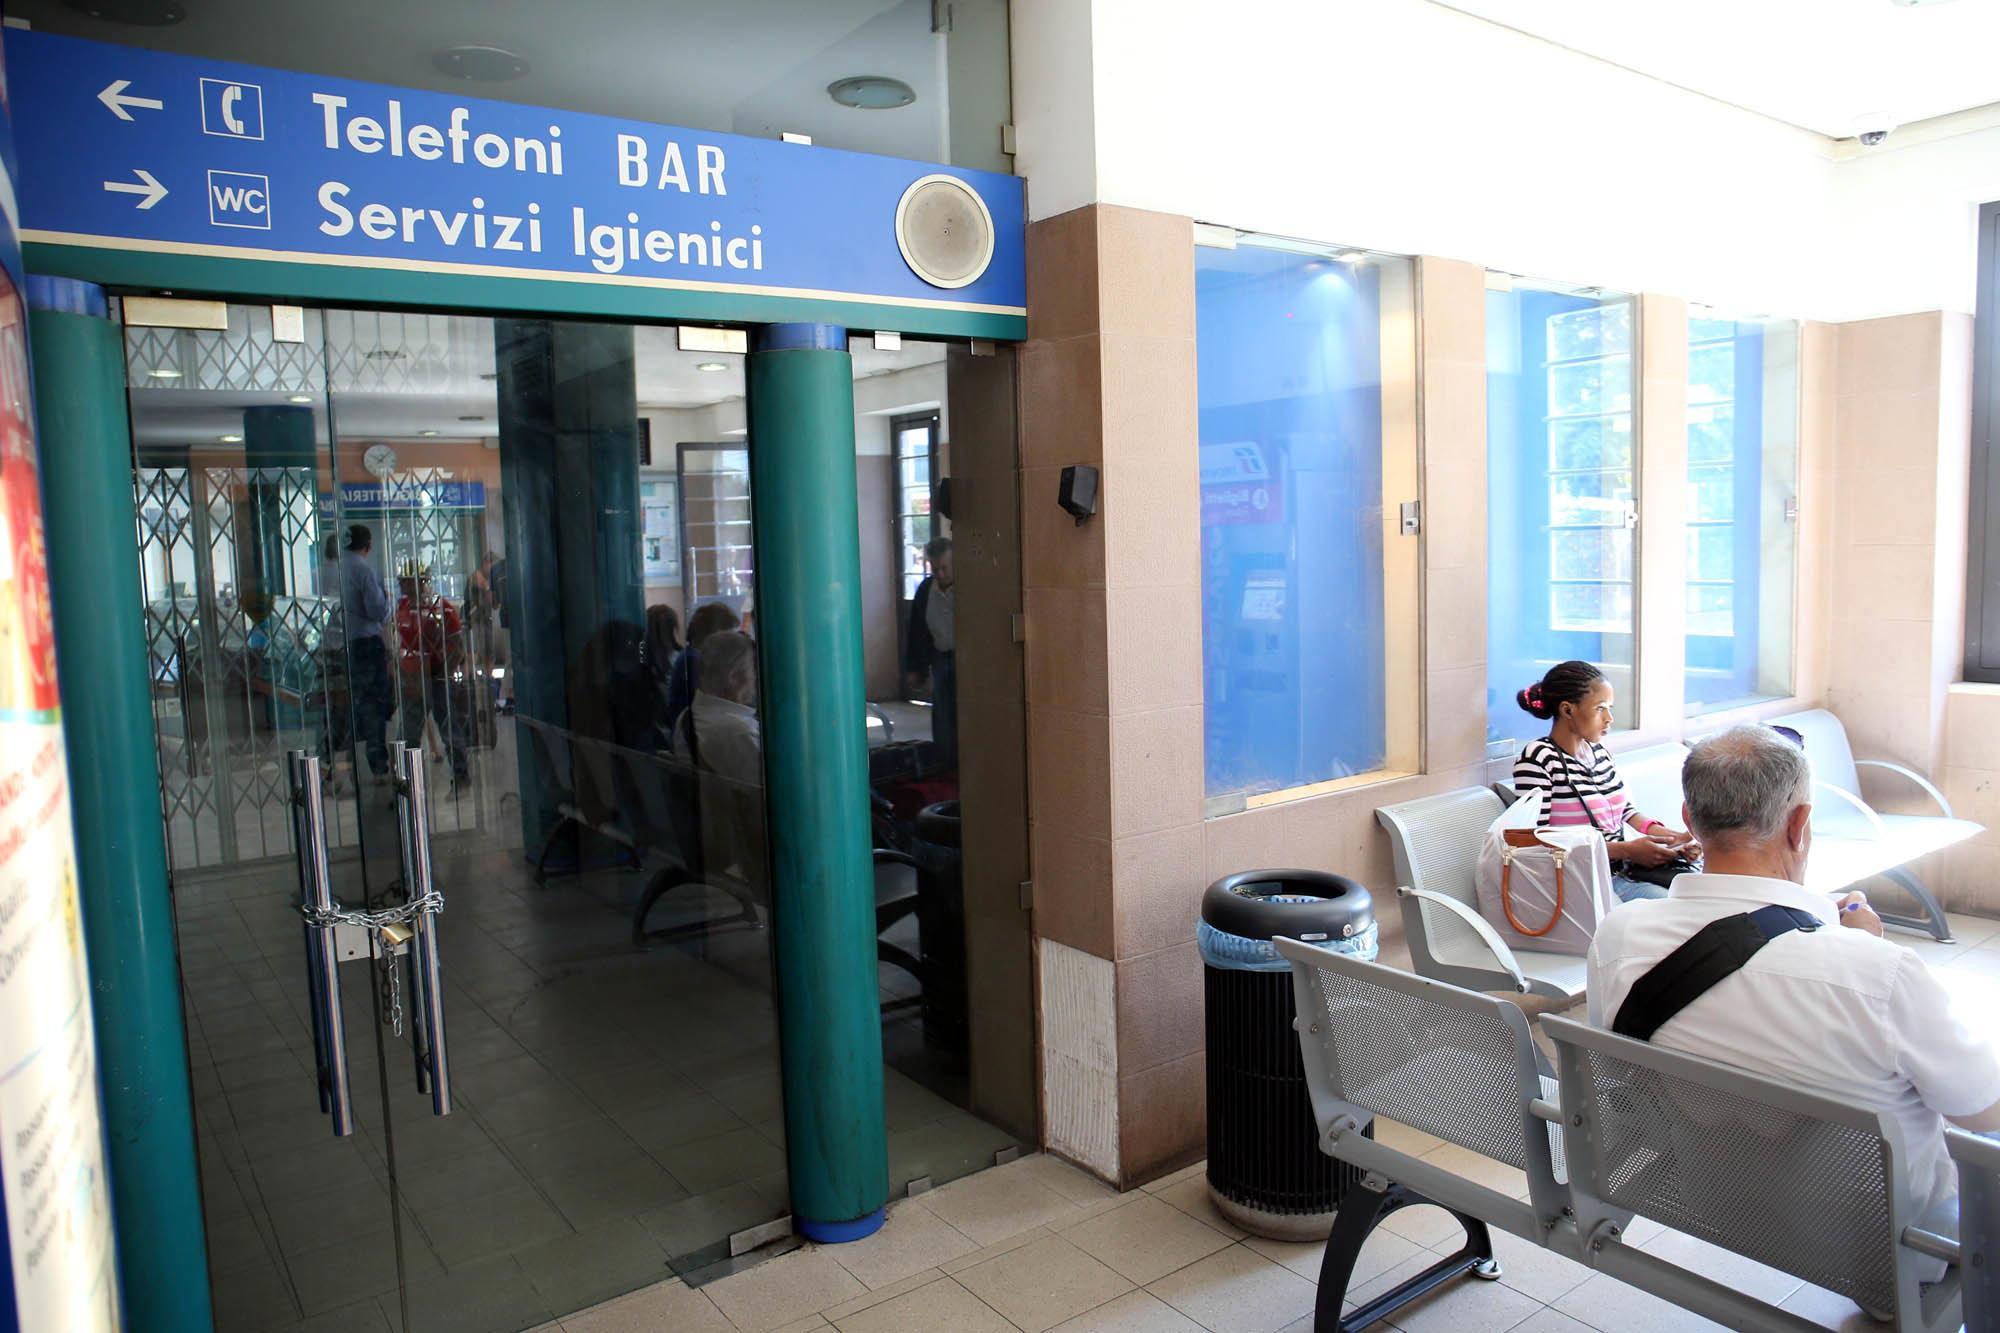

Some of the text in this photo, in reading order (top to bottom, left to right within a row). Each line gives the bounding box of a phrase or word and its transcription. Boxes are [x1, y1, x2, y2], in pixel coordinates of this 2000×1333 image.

[312, 92, 728, 196] Telefoni BAR
[212, 186, 266, 214] WC
[318, 181, 763, 274] Servizi Igienici
